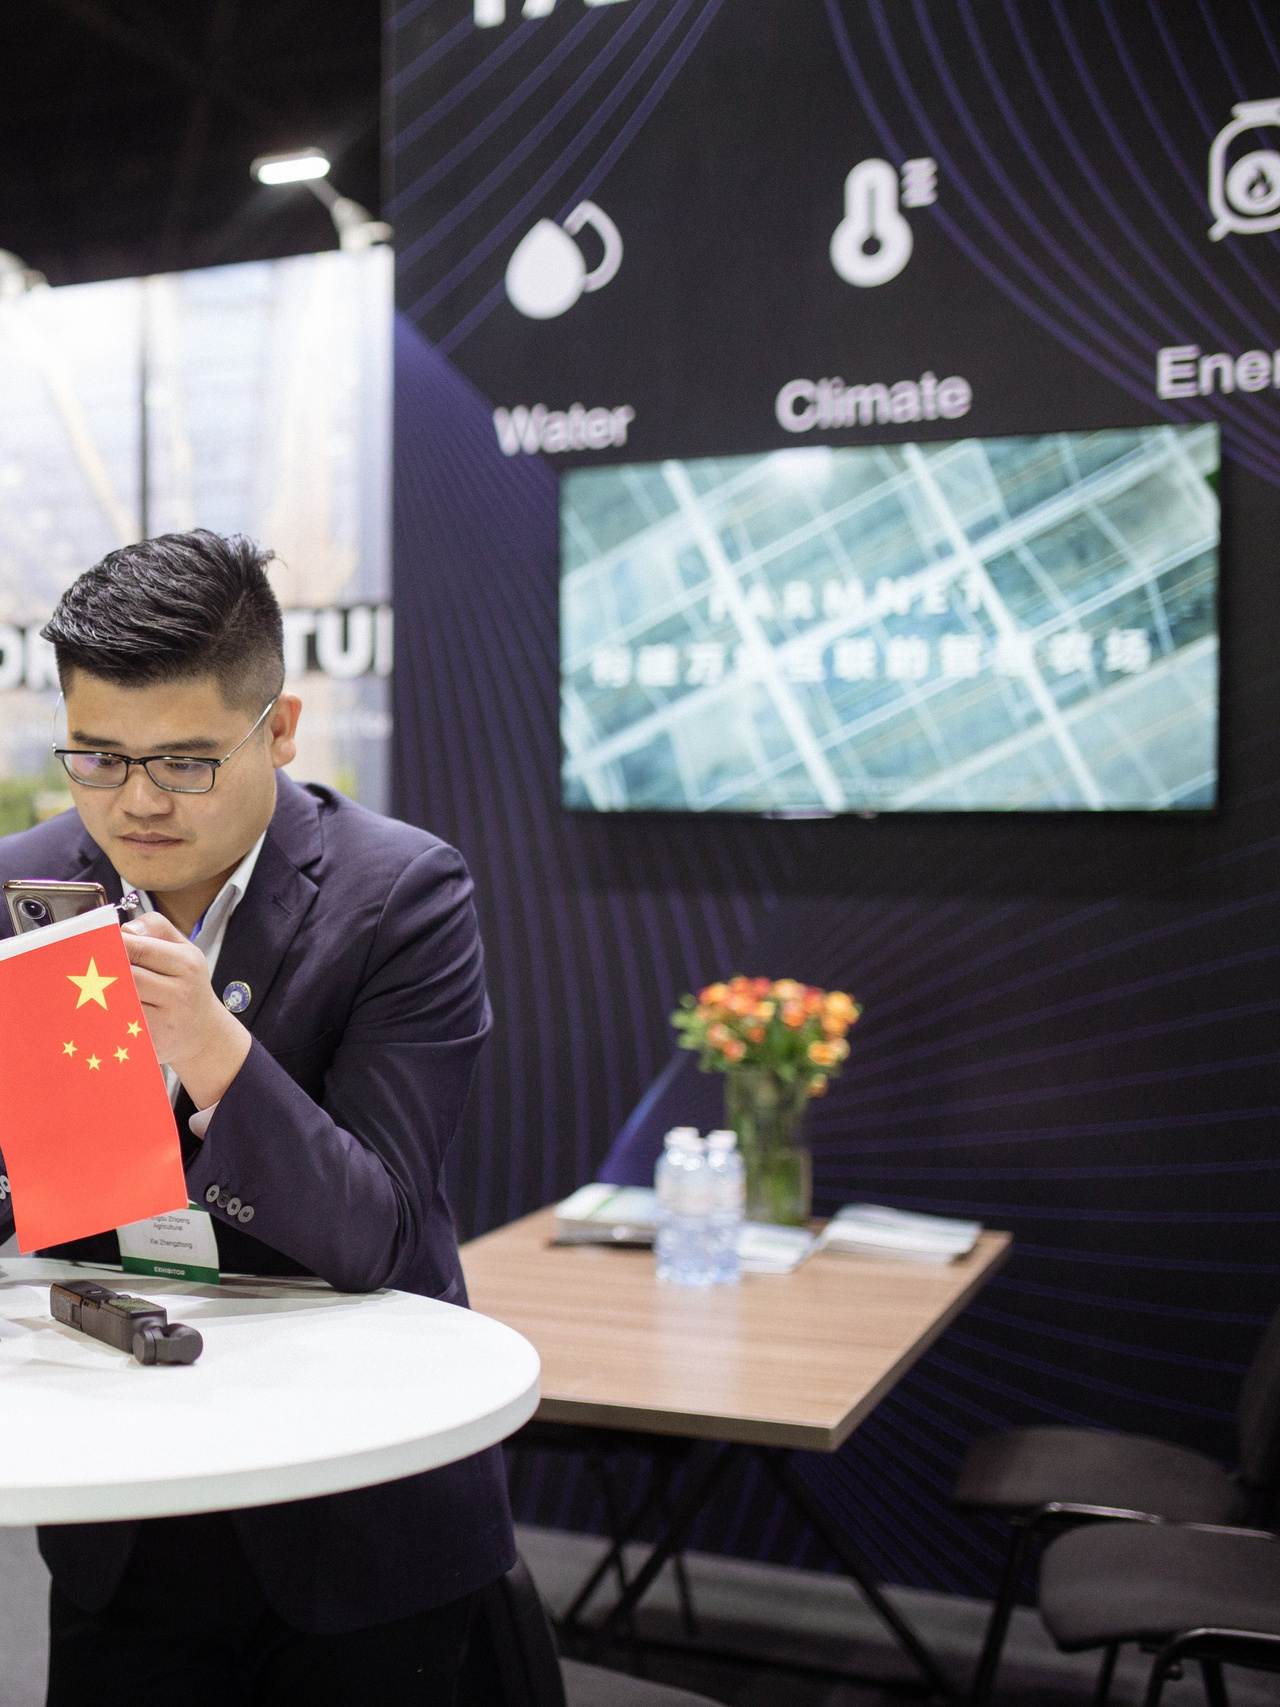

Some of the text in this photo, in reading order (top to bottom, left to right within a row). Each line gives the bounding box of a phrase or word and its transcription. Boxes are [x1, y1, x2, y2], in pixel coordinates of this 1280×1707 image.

[493, 402, 635, 456] Water
[775, 371, 972, 434] Climate
[154, 1267, 185, 1276] EXHIBITOR
